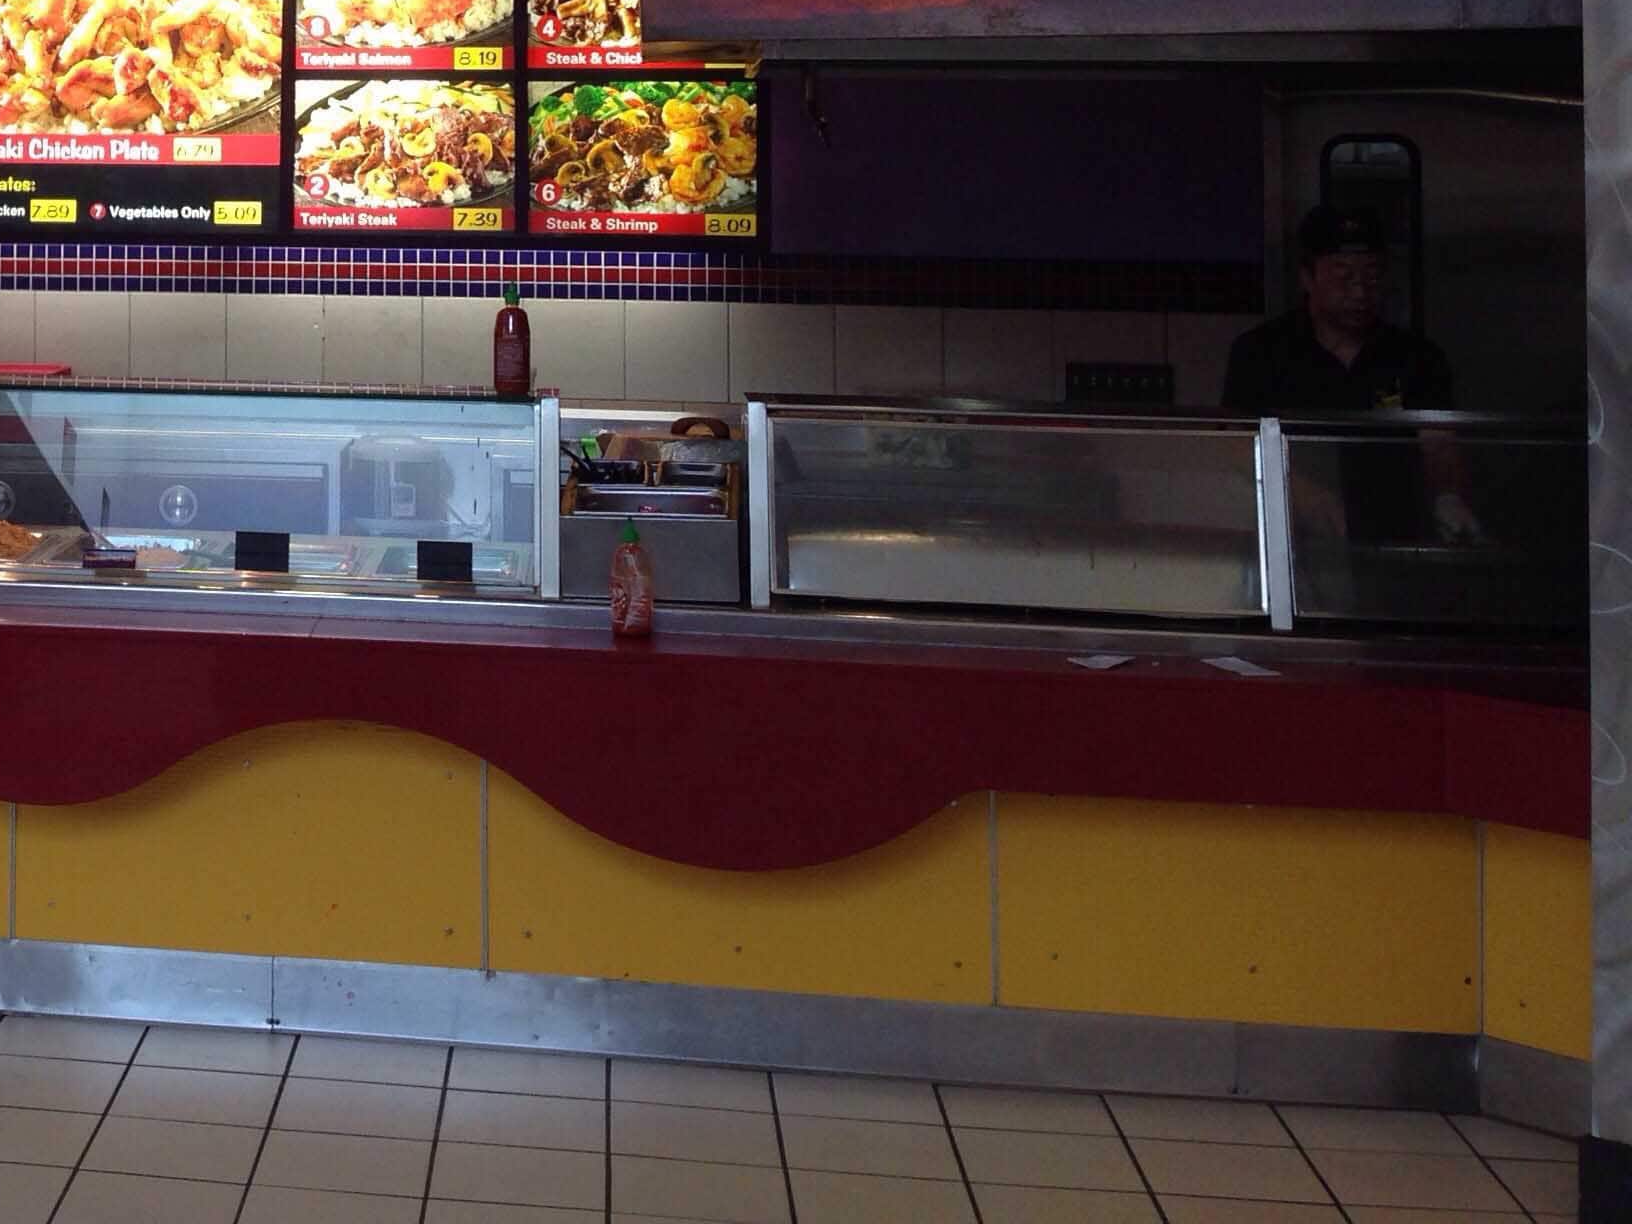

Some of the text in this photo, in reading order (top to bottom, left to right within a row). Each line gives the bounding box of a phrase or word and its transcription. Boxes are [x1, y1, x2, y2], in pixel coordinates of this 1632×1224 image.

[542, 17, 554, 36] 4
[301, 52, 412, 67] Teriyaki Salmon
[460, 52, 496, 65] 8.19
[546, 51, 587, 65] Steak
[590, 51, 603, 65] &
[28, 138, 105, 161] Chicken
[109, 138, 160, 161] Plate
[311, 177, 324, 197] 2
[542, 184, 556, 202] 6
[109, 205, 178, 221] Vegetables
[181, 206, 211, 221] Only
[300, 212, 397, 227] Teriyaki Steak
[456, 211, 497, 227] 7.39
[546, 216, 659, 233] Steak & Shrimp
[707, 218, 752, 234] 8.09
